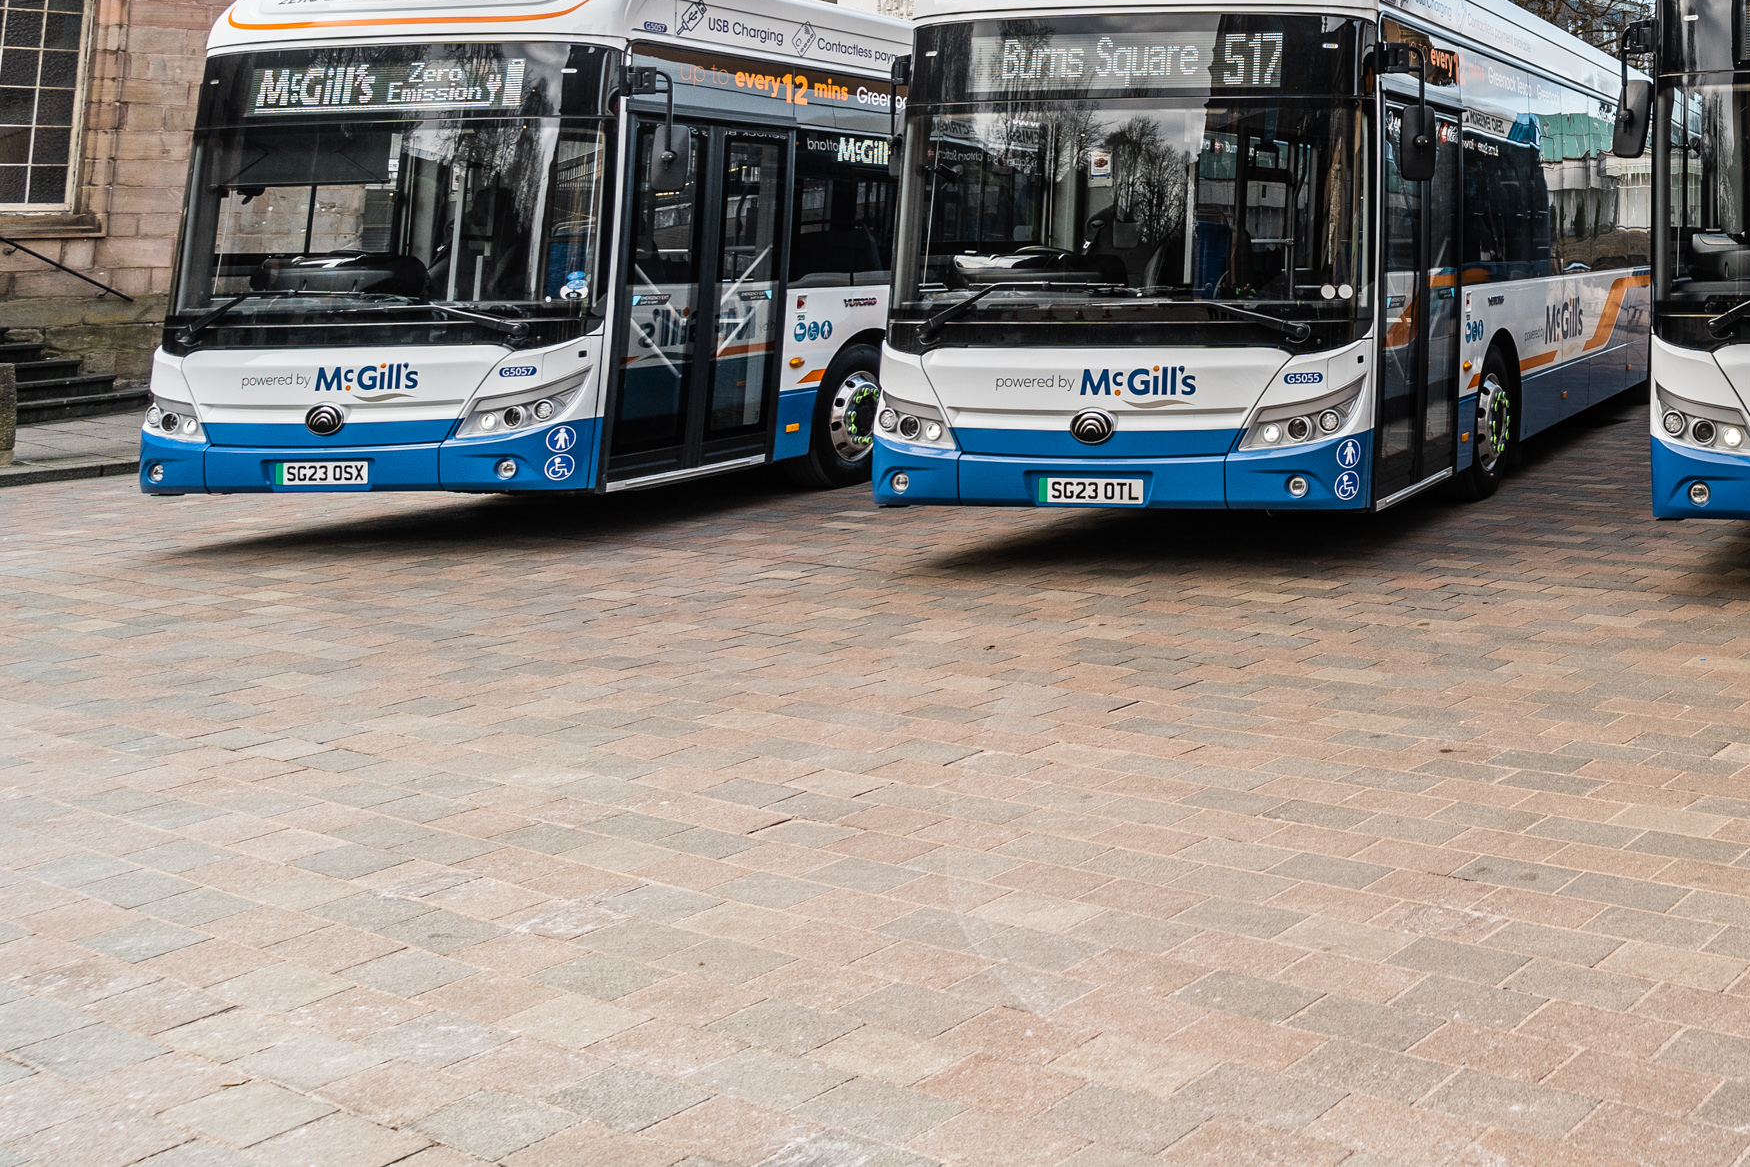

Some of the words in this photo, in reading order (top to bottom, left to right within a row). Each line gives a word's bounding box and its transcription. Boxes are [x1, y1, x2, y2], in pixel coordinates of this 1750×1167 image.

[646, 22, 667, 32] G5057
[708, 17, 730, 33] USB
[732, 21, 784, 46] Charging
[817, 37, 873, 60] Contactless
[408, 62, 463, 84] Zero
[1002, 39, 1084, 79] Burns
[1096, 36, 1199, 87] Square
[1223, 32, 1284, 85] 517
[1430, 48, 1453, 78] every
[1453, 51, 1467, 87] 12
[1468, 57, 1485, 82] mins
[255, 64, 376, 107] McGill's
[387, 82, 482, 103] Emission
[680, 64, 706, 87] up
[711, 64, 730, 85] to
[734, 70, 781, 99] every
[782, 73, 808, 106] 12
[813, 78, 849, 102] mins
[1487, 65, 1517, 93] Greenock
[1516, 76, 1532, 98] Tesco
[1544, 296, 1583, 345] McGill's
[241, 373, 293, 390] powered
[295, 373, 312, 389] by
[314, 362, 419, 392] McGill's
[501, 366, 534, 377] G5057
[995, 375, 1054, 391] powered
[1058, 375, 1075, 391] by
[1079, 365, 1197, 397] McGill's
[1286, 372, 1320, 383] G5055
[287, 464, 328, 482] SG23
[332, 464, 365, 482] OSX
[1051, 481, 1098, 500] SG23
[1104, 481, 1139, 500] OTL
